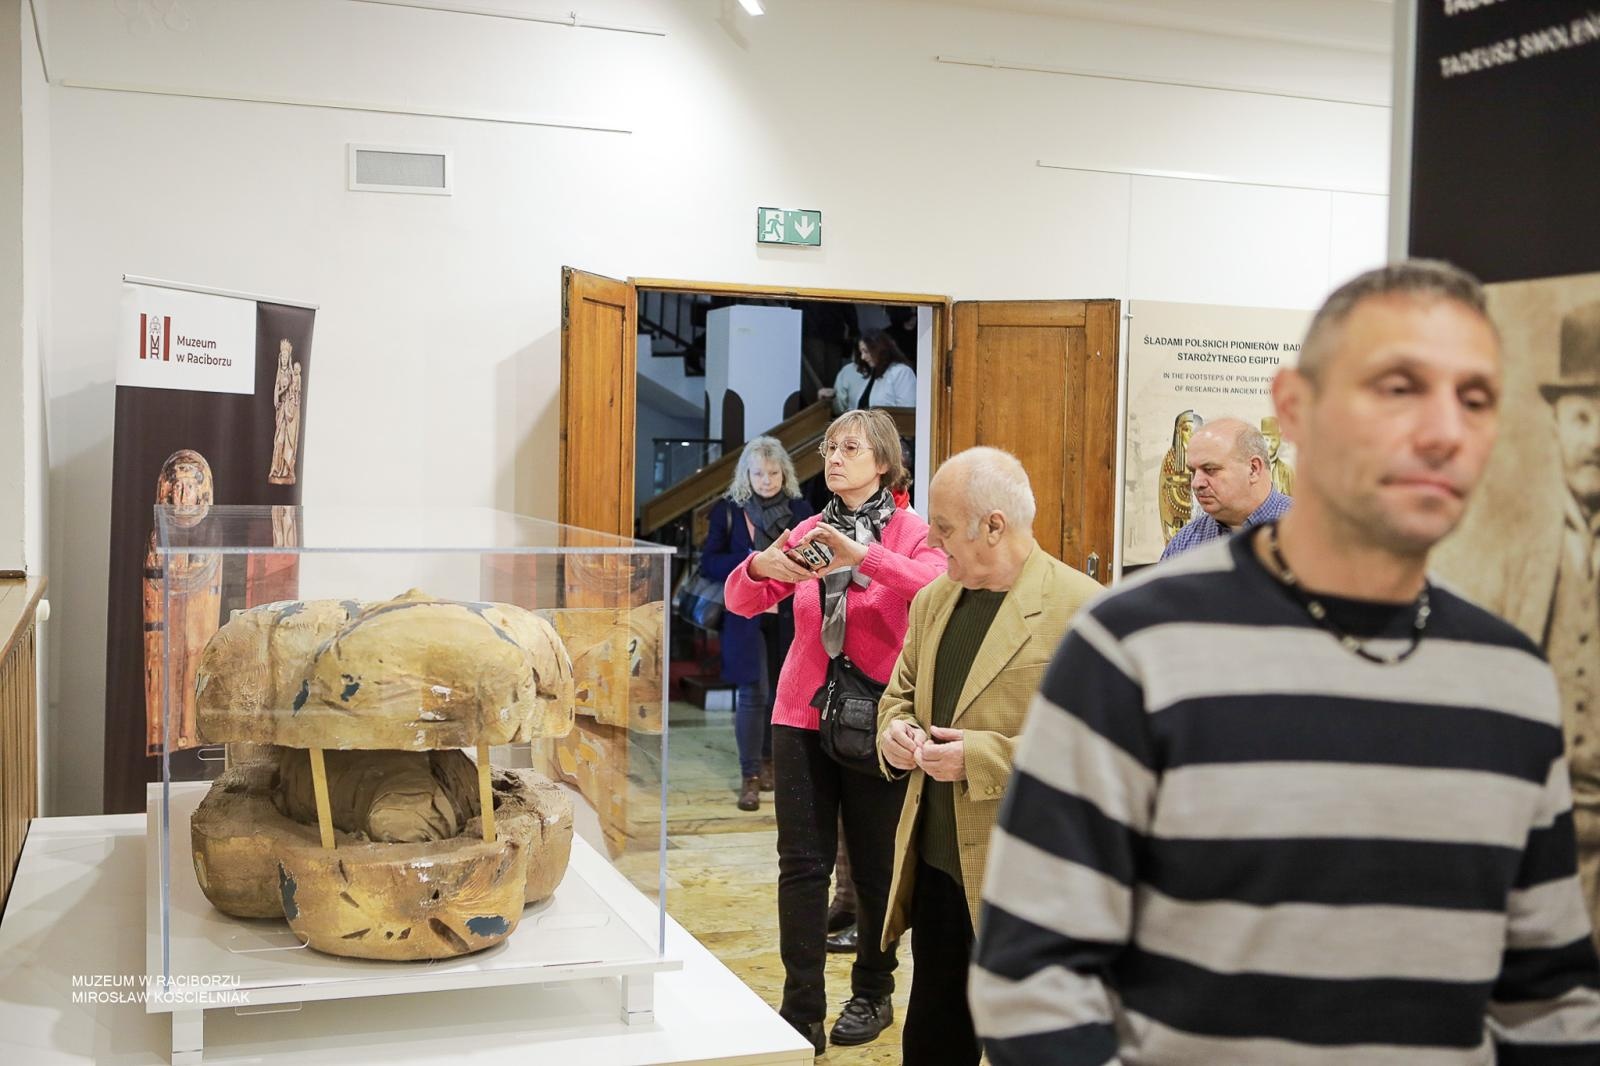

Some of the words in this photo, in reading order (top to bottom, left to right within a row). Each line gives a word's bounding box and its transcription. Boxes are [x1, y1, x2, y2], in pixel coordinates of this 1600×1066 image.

[1440, 38, 1517, 78] TADEUSZ
[177, 335, 217, 349] Muzeum
[1143, 336, 1183, 347] ŚLADAMI
[1185, 338, 1228, 349] POLSKICH
[1231, 341, 1280, 351] PIONIERÓW
[176, 355, 184, 363] w
[187, 353, 232, 367] Raciborzu
[1177, 352, 1247, 364] STAROŻYTNEGO
[1249, 356, 1280, 365] EGIPTU
[1185, 373, 1224, 382] FOOTSTEPS
[1185, 385, 1222, 393] RESEARCH
